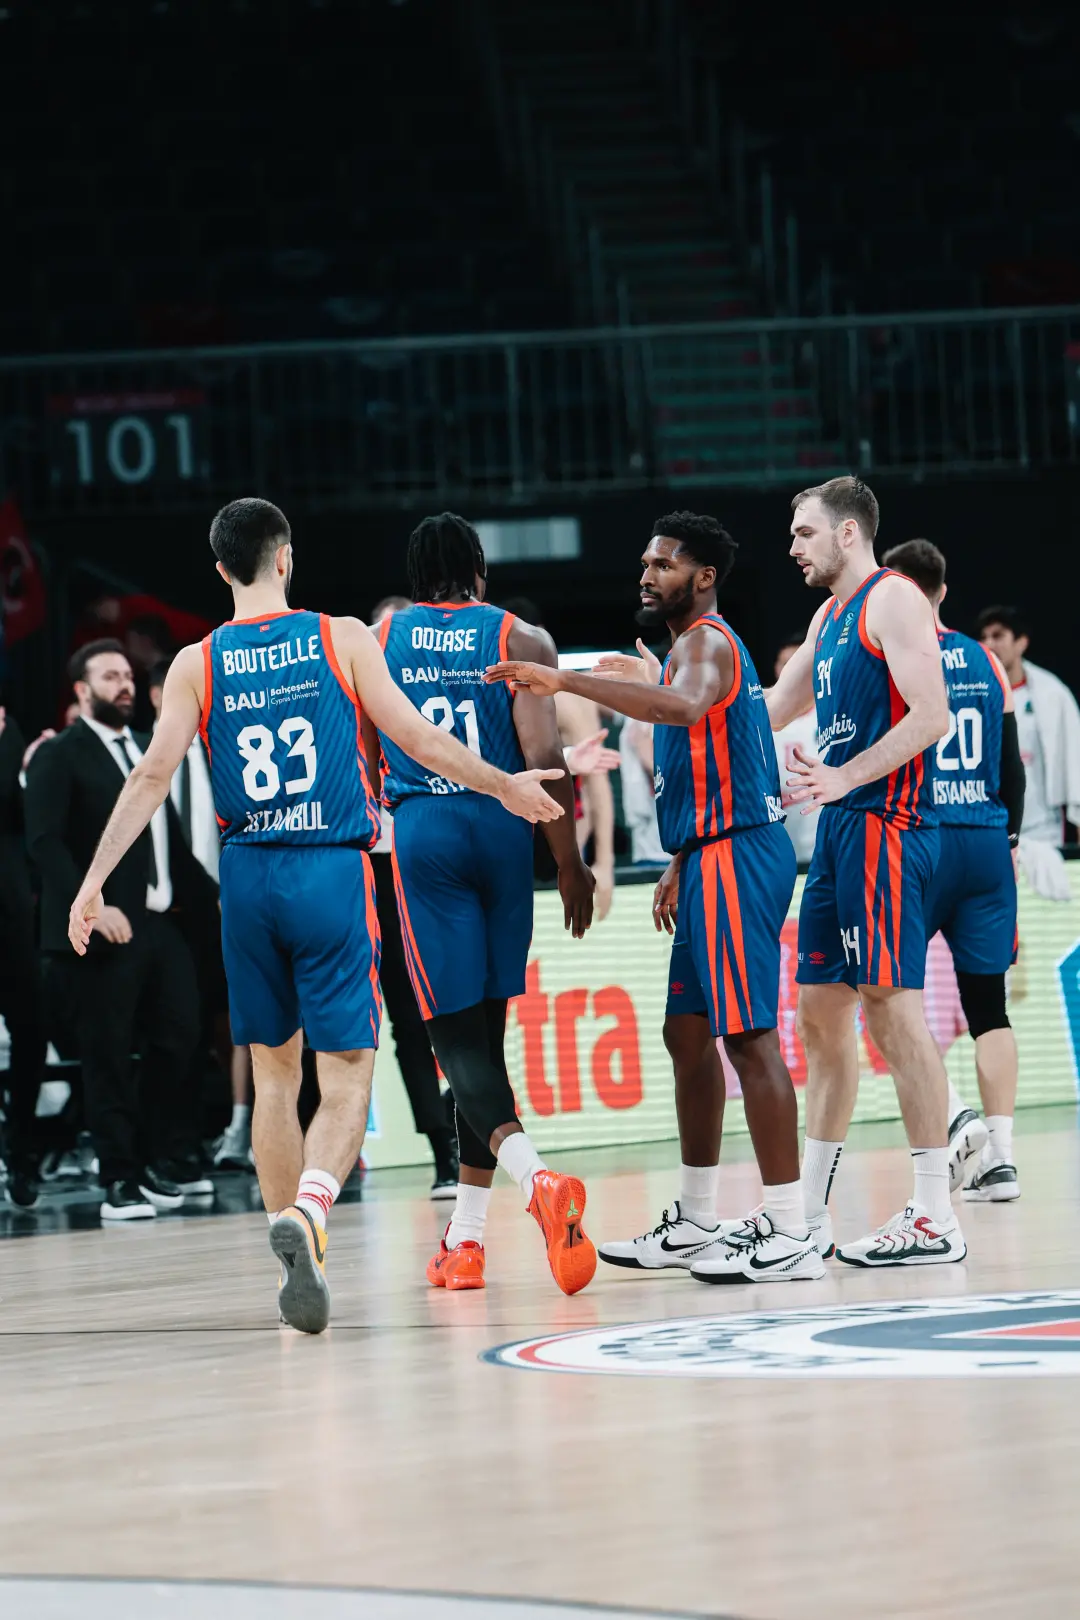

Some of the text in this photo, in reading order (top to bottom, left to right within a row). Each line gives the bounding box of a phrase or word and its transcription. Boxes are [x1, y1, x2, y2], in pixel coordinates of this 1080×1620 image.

[66, 414, 195, 485] 101
[222, 634, 320, 676] BOUTEILLE
[411, 626, 478, 652] ODIASE
[270, 679, 319, 697] Bahçeşehir
[401, 666, 439, 684] BAU
[817, 656, 834, 699] 34
[223, 690, 266, 713] BAU
[270, 690, 320, 706] Cyprus University
[236, 716, 317, 801] 83
[936, 707, 983, 771] 20
[505, 959, 644, 1117] tra
